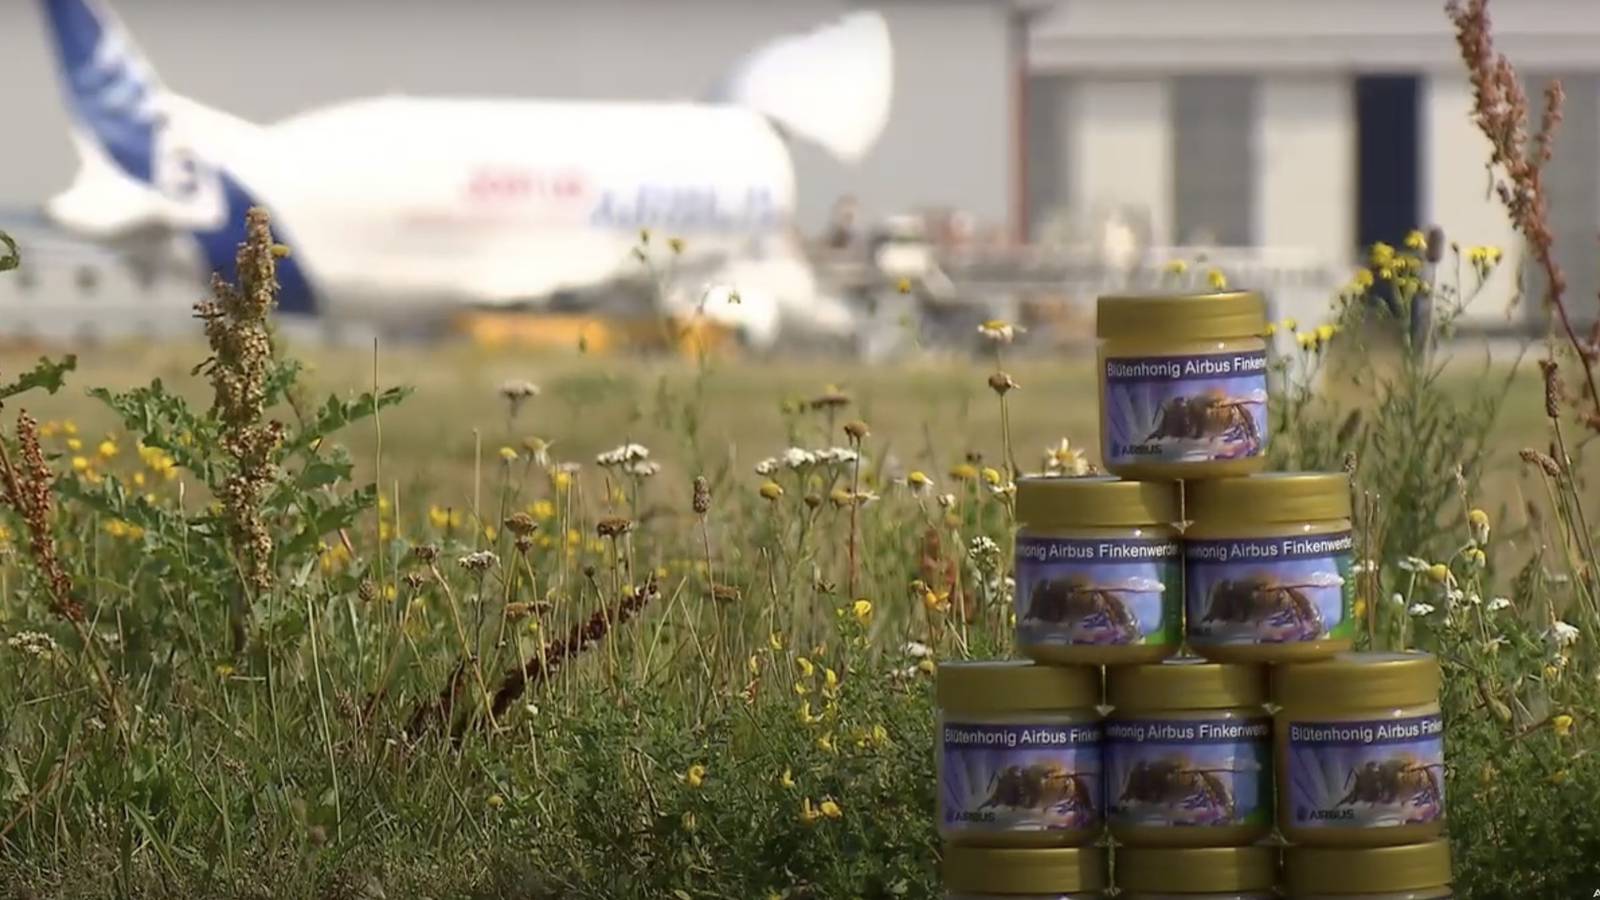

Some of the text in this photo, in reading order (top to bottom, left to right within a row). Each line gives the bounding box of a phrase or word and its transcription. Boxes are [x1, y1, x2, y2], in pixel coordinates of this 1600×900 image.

[1107, 361, 1180, 378] Blütenhonig
[1184, 359, 1231, 374] Airbus
[1049, 543, 1094, 559] Airbus
[1230, 542, 1278, 558] Airbus
[944, 728, 1017, 747] Blütenhonig
[1020, 728, 1067, 744] Airbus
[1148, 725, 1194, 740] Airbus
[1291, 726, 1373, 743] Blütenhonig
[1376, 724, 1419, 740] Airbus
